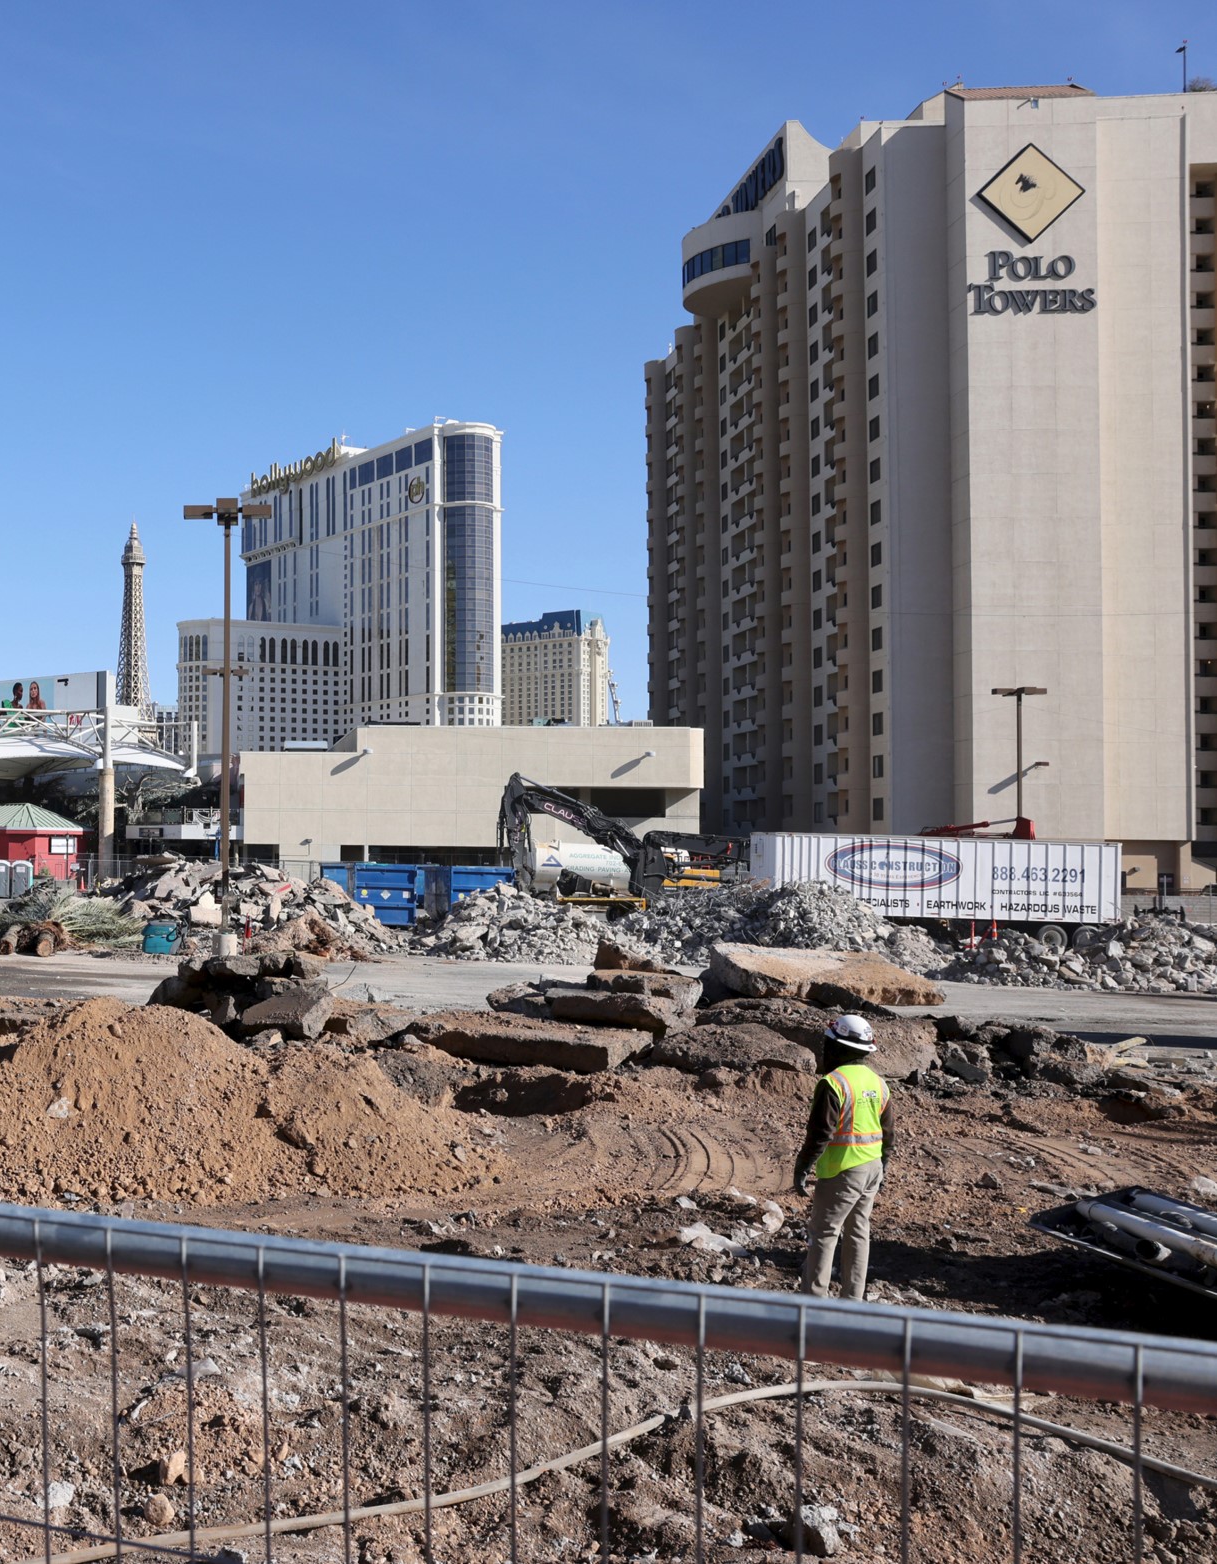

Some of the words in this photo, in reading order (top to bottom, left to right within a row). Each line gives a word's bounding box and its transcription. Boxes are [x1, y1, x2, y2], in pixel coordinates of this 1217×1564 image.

[985, 250, 1075, 282] POLO
[967, 282, 1097, 316] TOWERS
[250, 437, 342, 498] hollywood
[543, 802, 587, 826] CLAUSS
[992, 866, 1085, 884] 888.463.2291
[927, 900, 987, 911] EARTHWORK
[1000, 902, 1060, 914] HAZARDOUS
[1063, 905, 1097, 914] WASTE
